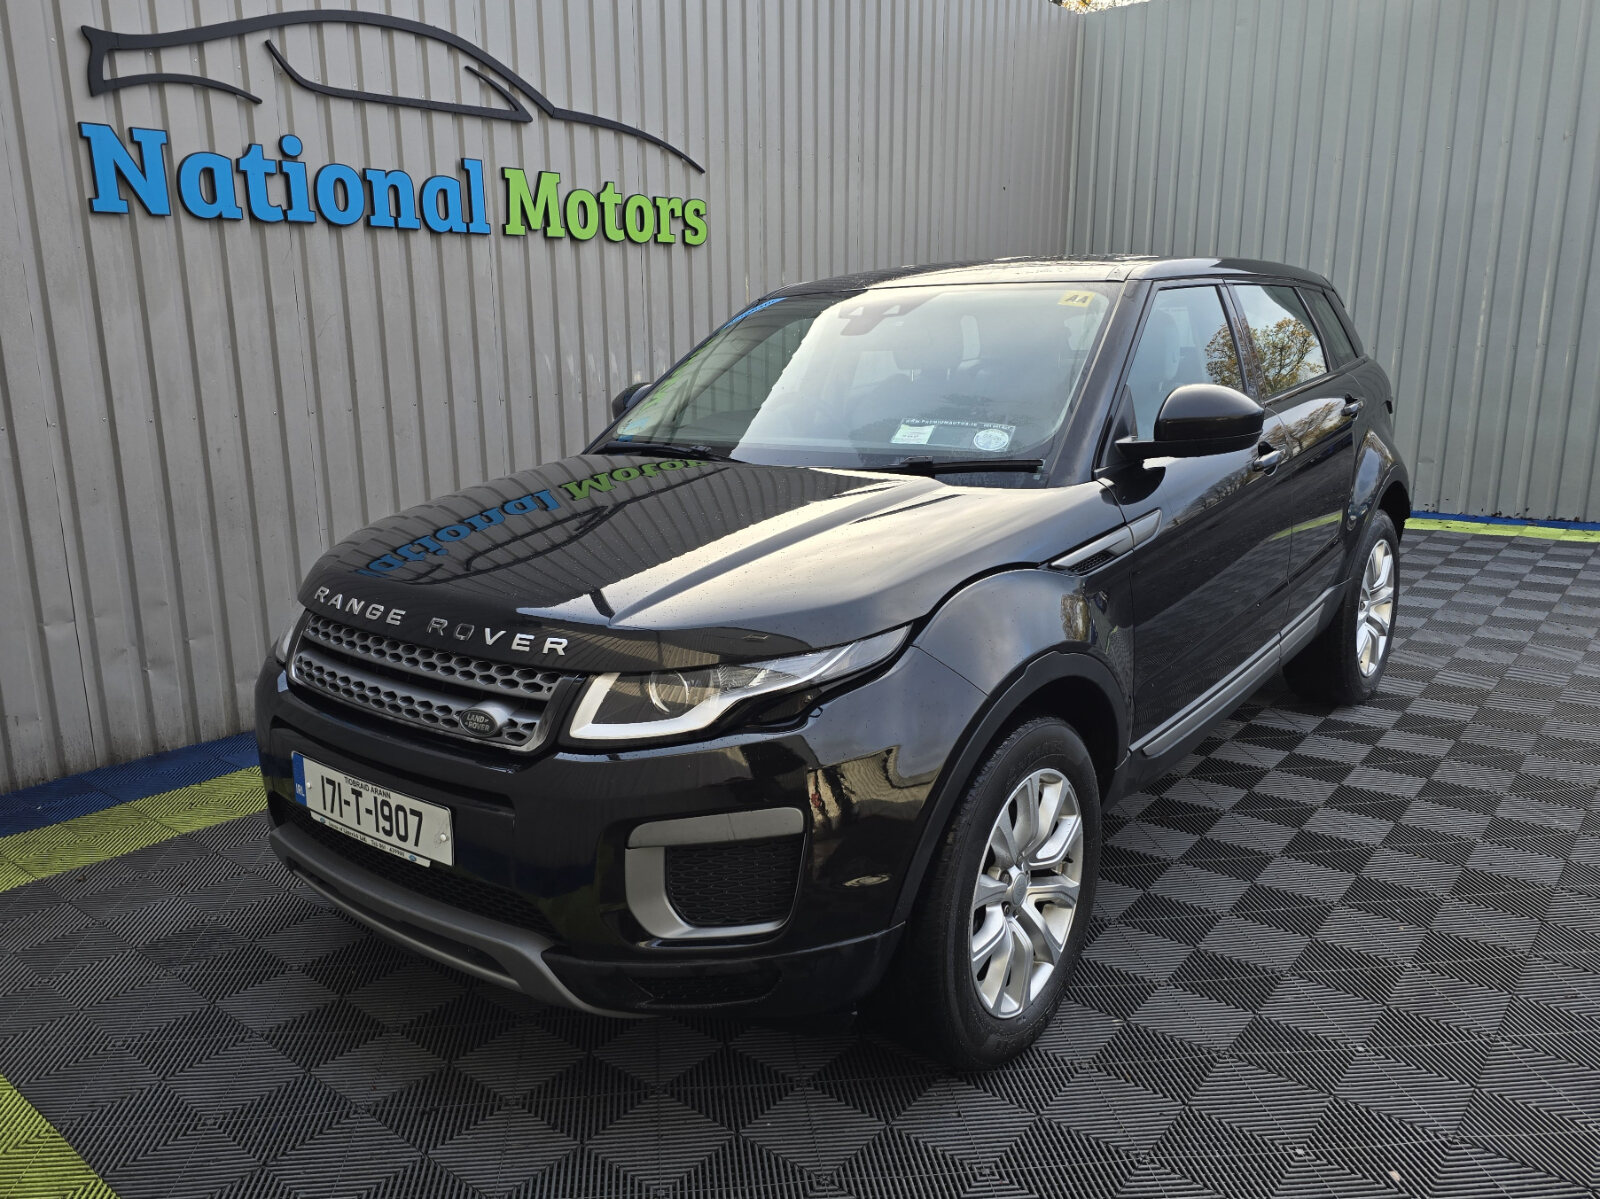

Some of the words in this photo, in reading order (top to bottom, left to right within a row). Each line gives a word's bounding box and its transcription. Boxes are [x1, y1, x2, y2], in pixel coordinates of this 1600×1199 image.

[78, 121, 491, 236] National
[502, 166, 708, 247] Motors
[1064, 295, 1089, 303] AA
[313, 586, 406, 626] RANGE
[426, 617, 569, 656] ROVER
[466, 713, 485, 723] LAND
[468, 720, 490, 732] ROVER
[321, 775, 423, 847] 171-T-1907
